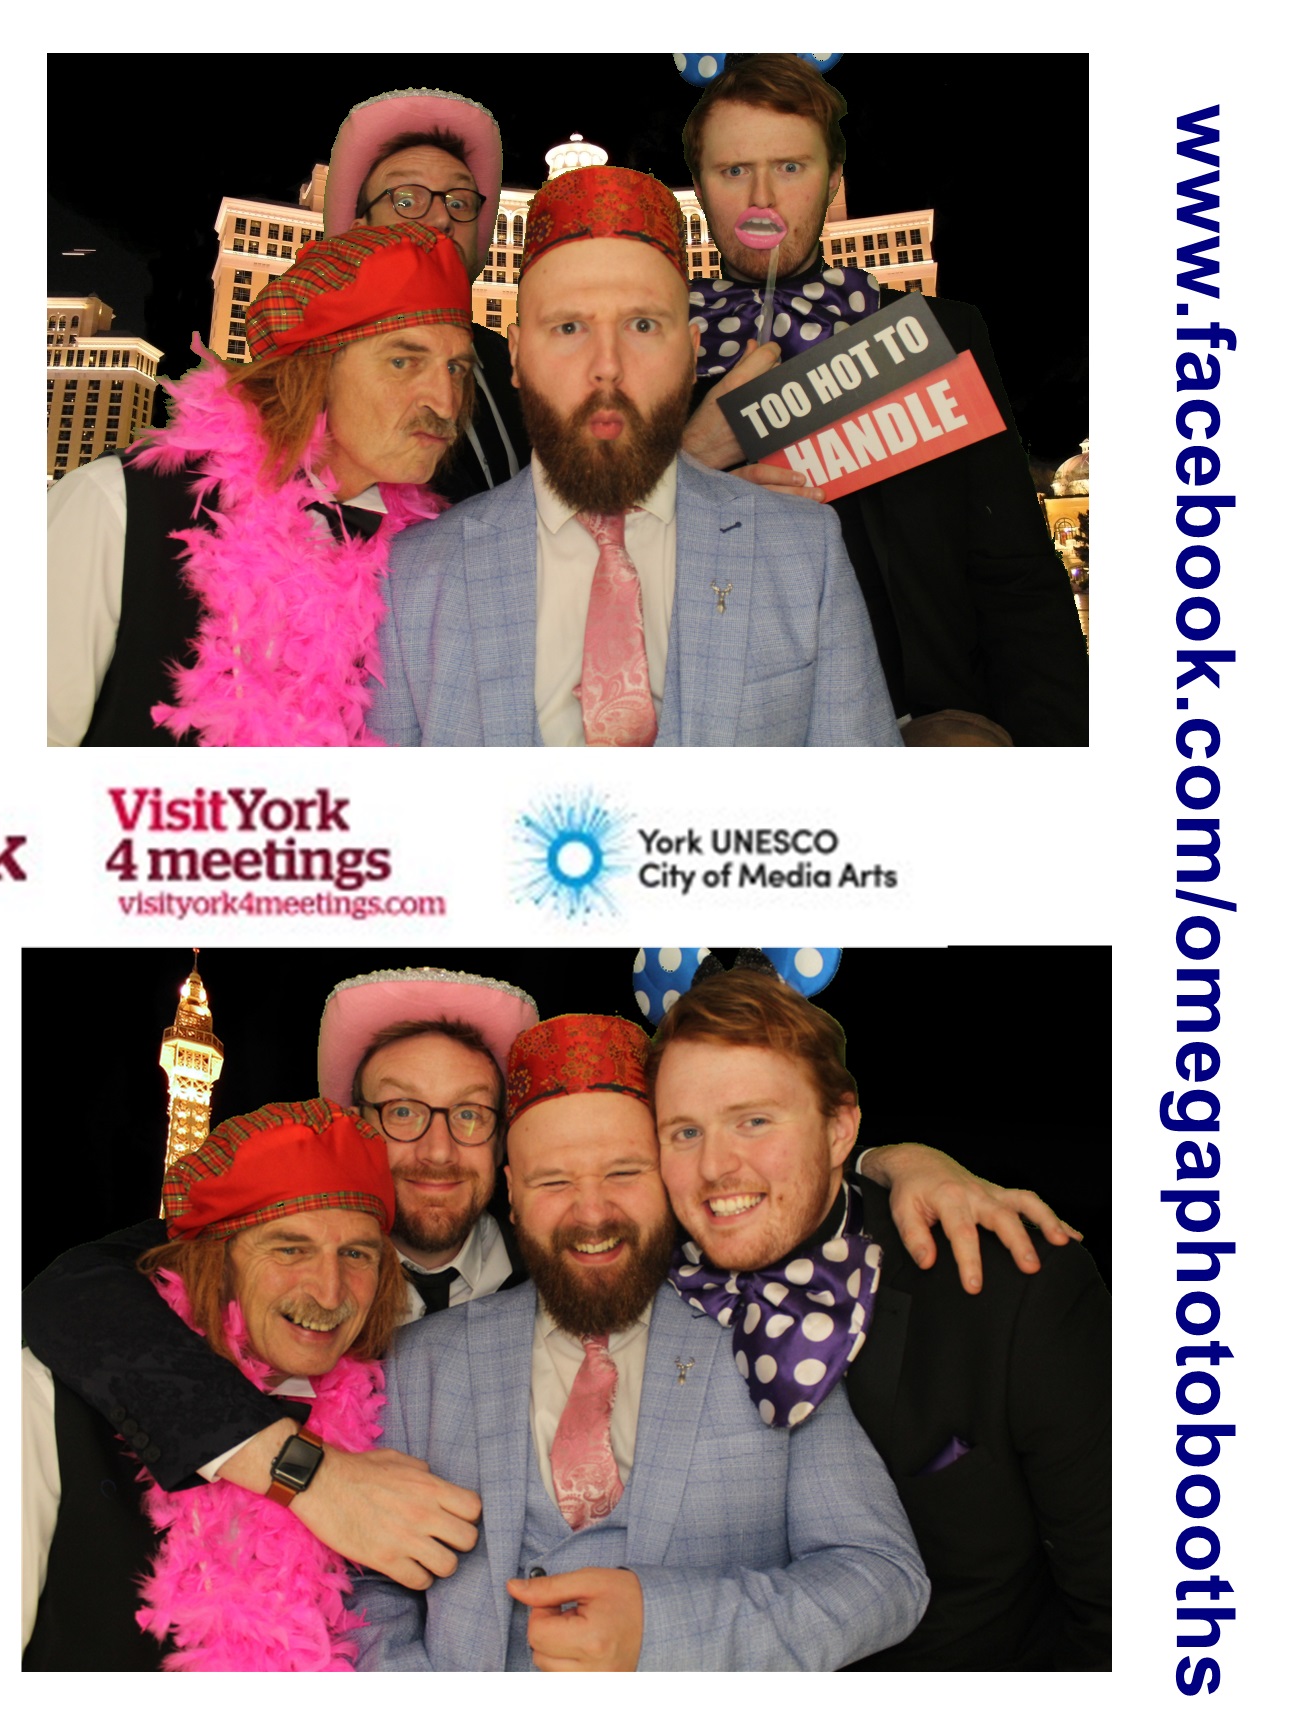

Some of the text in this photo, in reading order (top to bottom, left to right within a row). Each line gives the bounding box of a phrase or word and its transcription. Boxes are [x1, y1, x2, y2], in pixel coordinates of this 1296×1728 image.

[740, 315, 929, 439] TOO HOT TO
[783, 379, 969, 488] HANDLE
